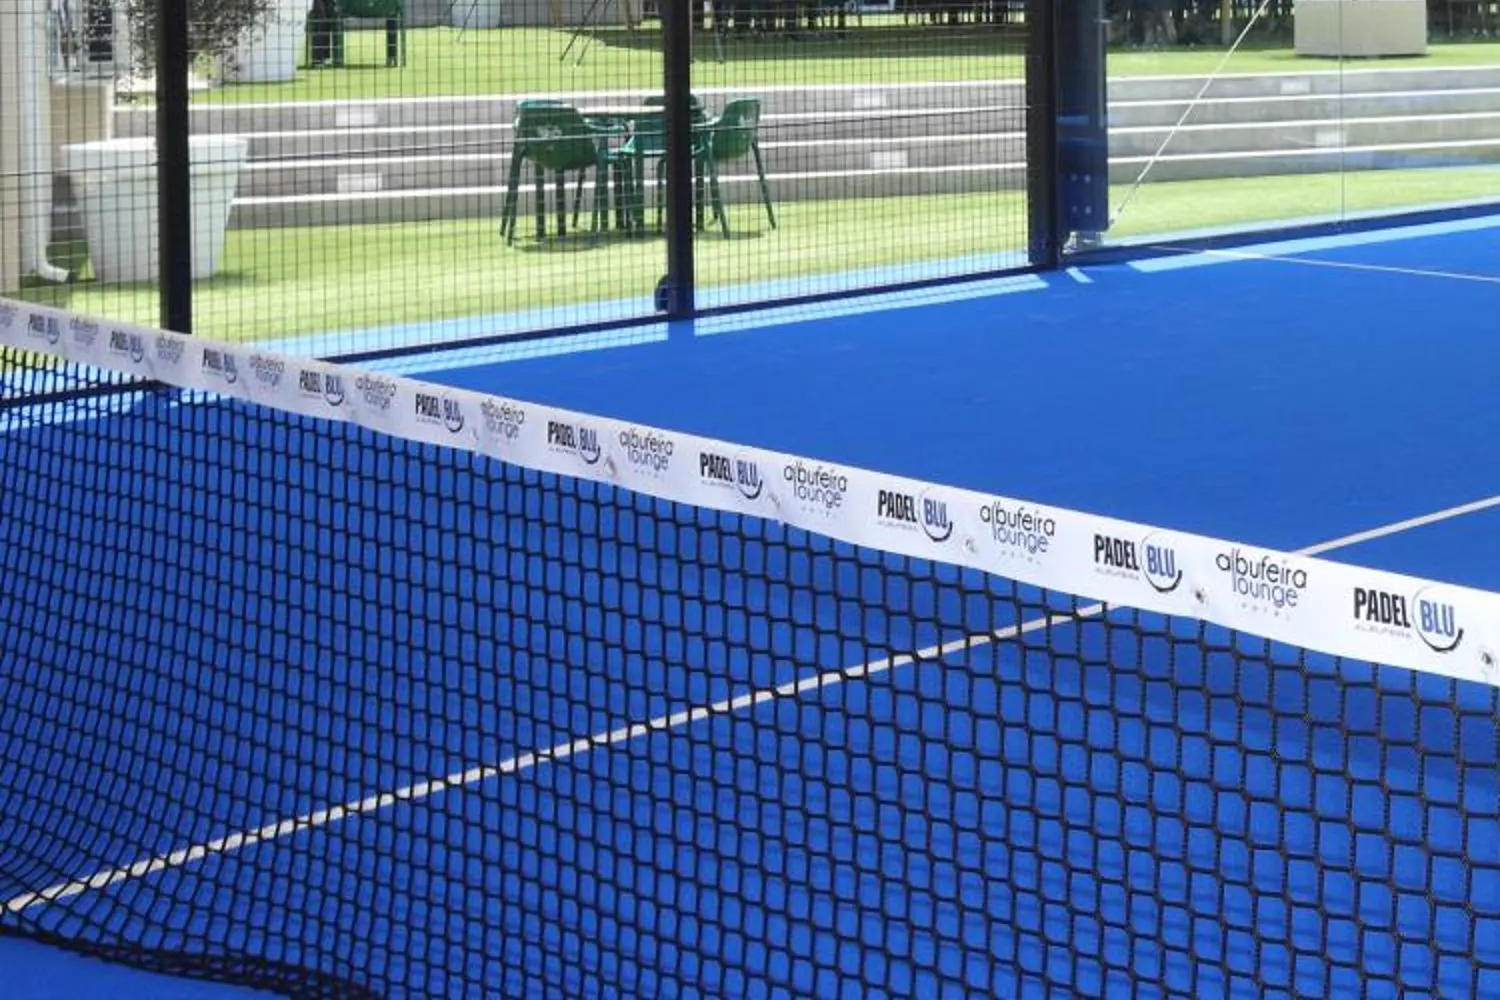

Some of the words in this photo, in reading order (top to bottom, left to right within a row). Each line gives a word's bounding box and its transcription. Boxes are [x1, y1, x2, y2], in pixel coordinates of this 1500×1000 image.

[699, 452, 733, 483] PADEL
[737, 460, 758, 487] BLU
[783, 461, 848, 493] albufeira
[794, 479, 842, 509] lounge
[877, 489, 918, 523] PADEL
[924, 497, 948, 530] BLU
[979, 500, 1056, 537] albufeira
[993, 520, 1049, 554] lounge
[1094, 533, 1140, 571] PADEL
[1146, 545, 1176, 579] BLU
[1215, 547, 1308, 589] albufeira
[1232, 568, 1299, 609] lounge
[1353, 587, 1411, 629] PADEL
[1419, 599, 1455, 638] BLU
